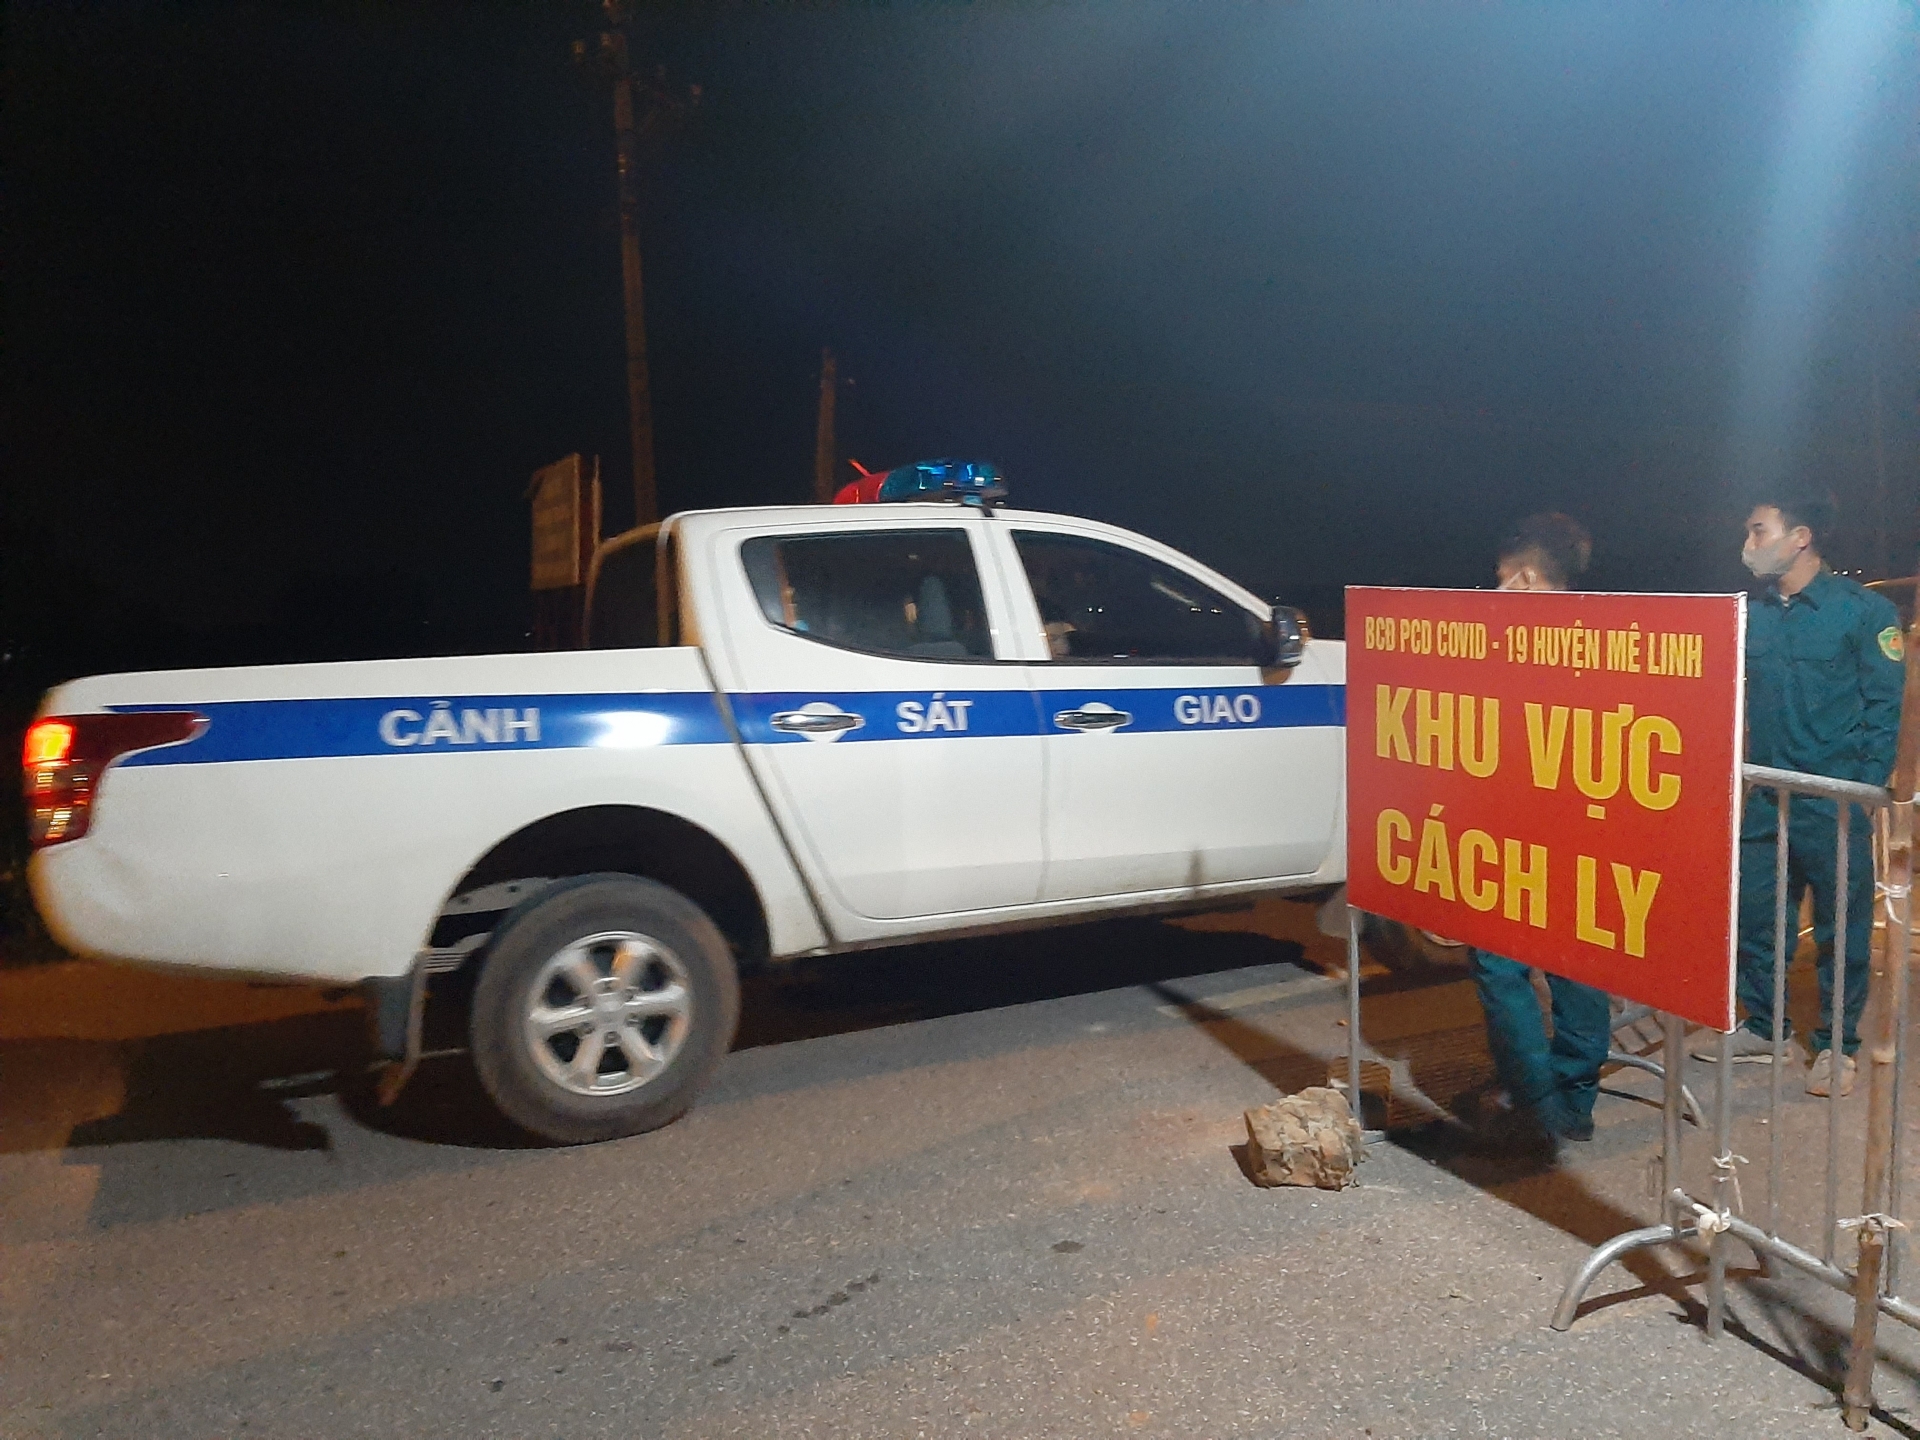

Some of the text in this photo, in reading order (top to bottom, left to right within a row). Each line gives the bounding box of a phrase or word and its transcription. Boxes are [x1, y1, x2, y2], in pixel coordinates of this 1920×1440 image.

[1437, 620, 1487, 660] COVID
[1505, 625, 1528, 664] 19
[1533, 619, 1600, 678] HUYỆN
[1606, 621, 1642, 673] MÊ
[1647, 632, 1703, 678] LINH
[379, 692, 1262, 747] CẢNH SÁT GIAO
[1376, 683, 1682, 820] KHU VỰC
[1376, 803, 1661, 958] CÁCH LY
